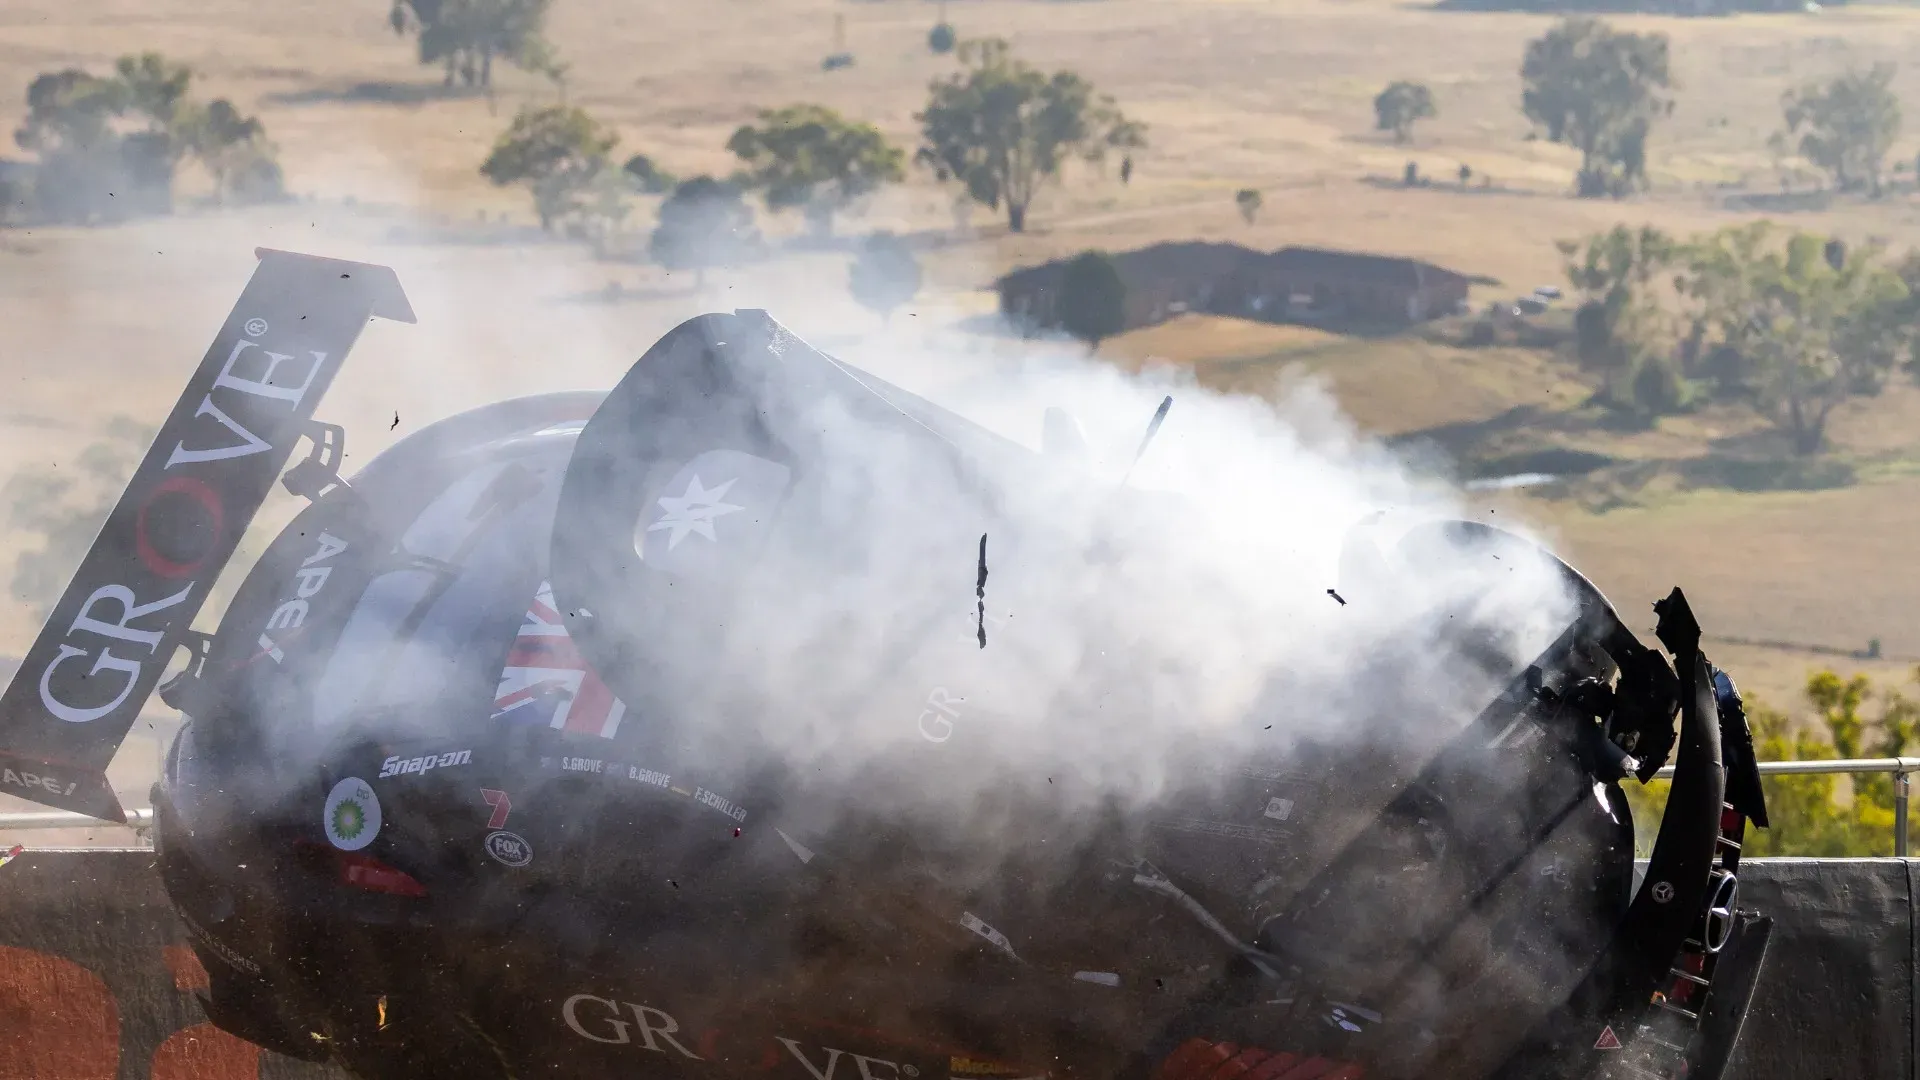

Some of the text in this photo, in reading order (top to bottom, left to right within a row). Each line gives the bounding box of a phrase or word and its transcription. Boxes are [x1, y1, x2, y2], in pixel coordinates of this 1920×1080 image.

[378, 749, 472, 779] Snap-on
[562, 756, 748, 823] S.GROVE B.GROVE F.SCHILLER
[495, 837, 523, 857] FOX
